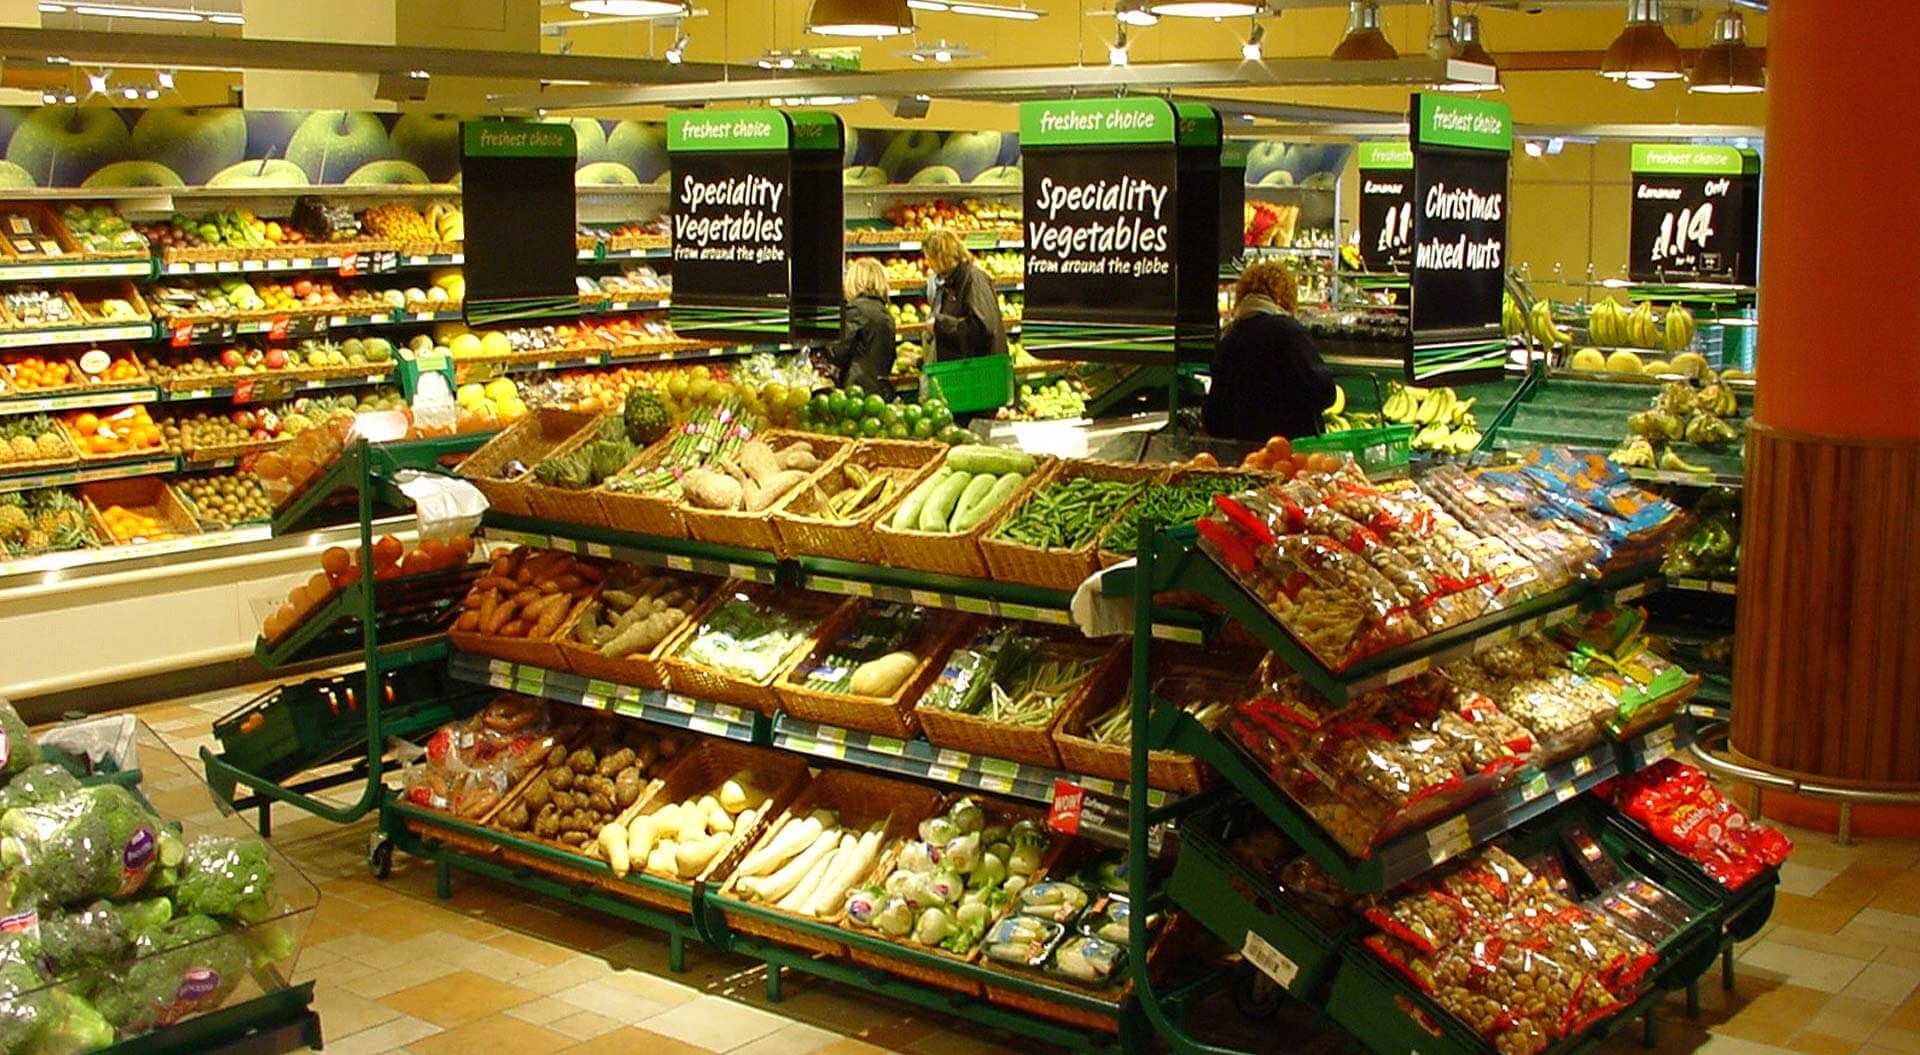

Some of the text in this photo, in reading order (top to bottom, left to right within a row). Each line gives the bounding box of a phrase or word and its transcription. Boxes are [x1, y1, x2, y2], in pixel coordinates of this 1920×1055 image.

[682, 120, 771, 141] freshest choice
[1040, 111, 1103, 132] freshest
[1106, 110, 1155, 129] choice
[1433, 104, 1502, 135] freshest choice
[680, 173, 784, 213] Speciality
[1036, 175, 1168, 220] Speciality
[1425, 182, 1502, 220] Christmas
[1704, 178, 1730, 197] Only
[675, 209, 783, 247] Vegetables
[1028, 215, 1168, 259] Vegetables
[675, 244, 785, 264] from around the globe
[1027, 254, 1169, 278] from around the globe
[1416, 233, 1501, 270] mixed nuts
